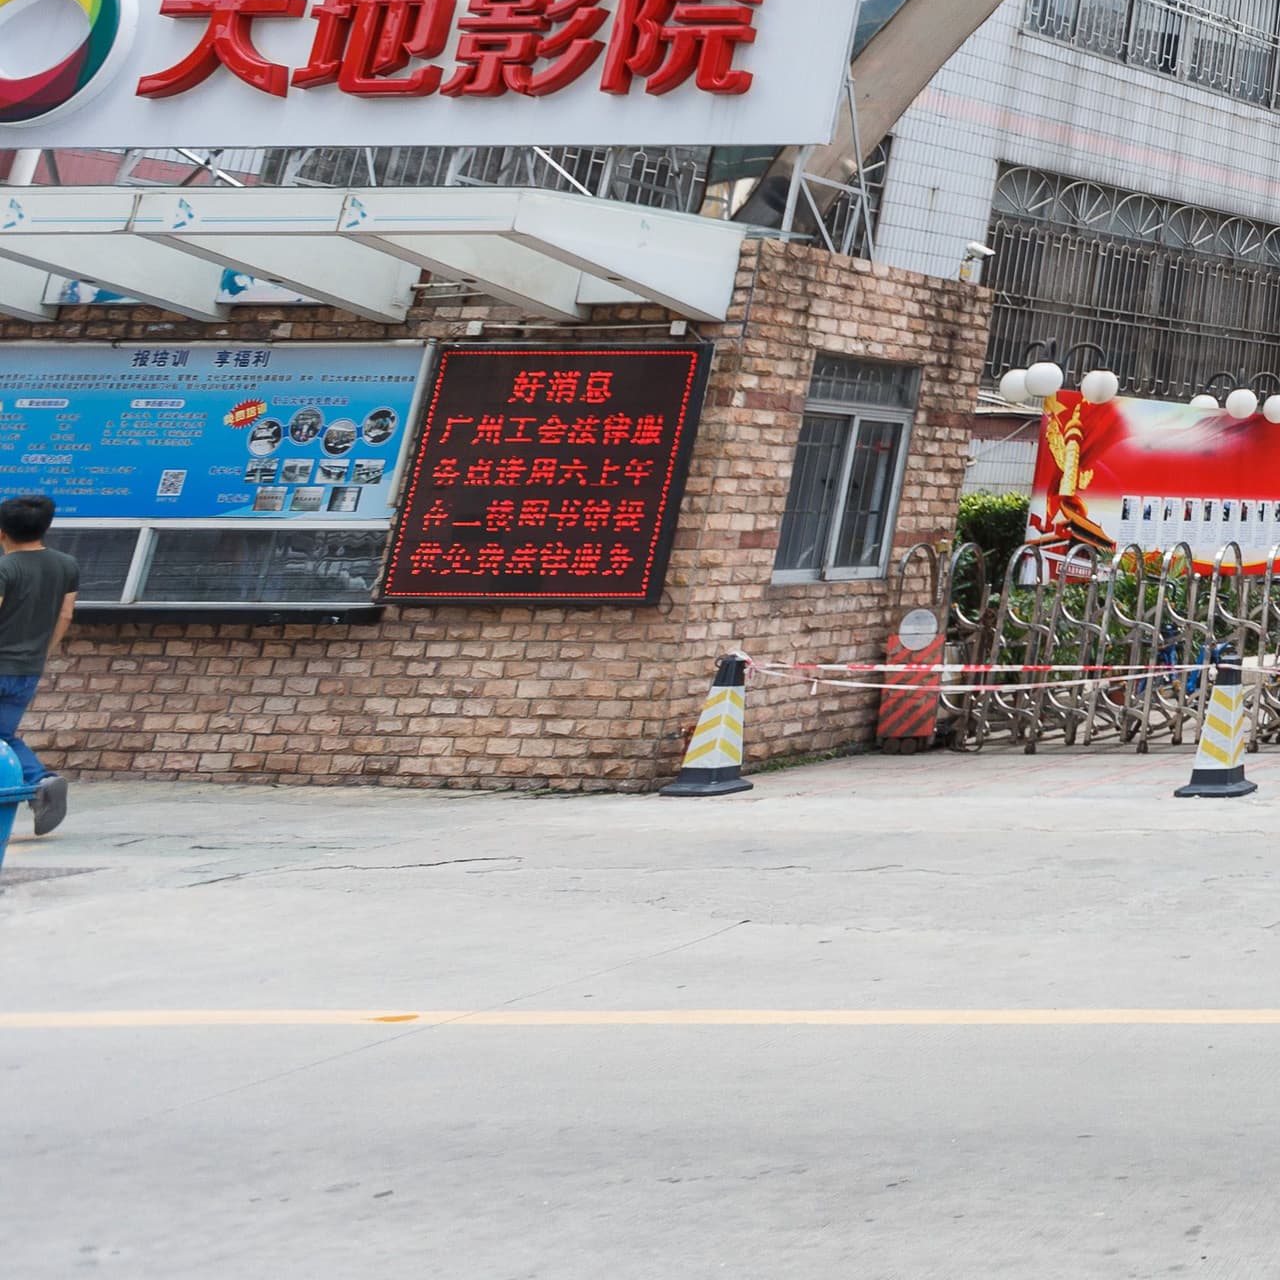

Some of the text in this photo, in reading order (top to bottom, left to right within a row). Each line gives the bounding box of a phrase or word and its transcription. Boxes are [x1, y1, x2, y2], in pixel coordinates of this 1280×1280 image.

[131, 350, 272, 368] 报培训 享福利
[507, 370, 614, 404] 好消息
[438, 413, 665, 446] 广州工会法律服
